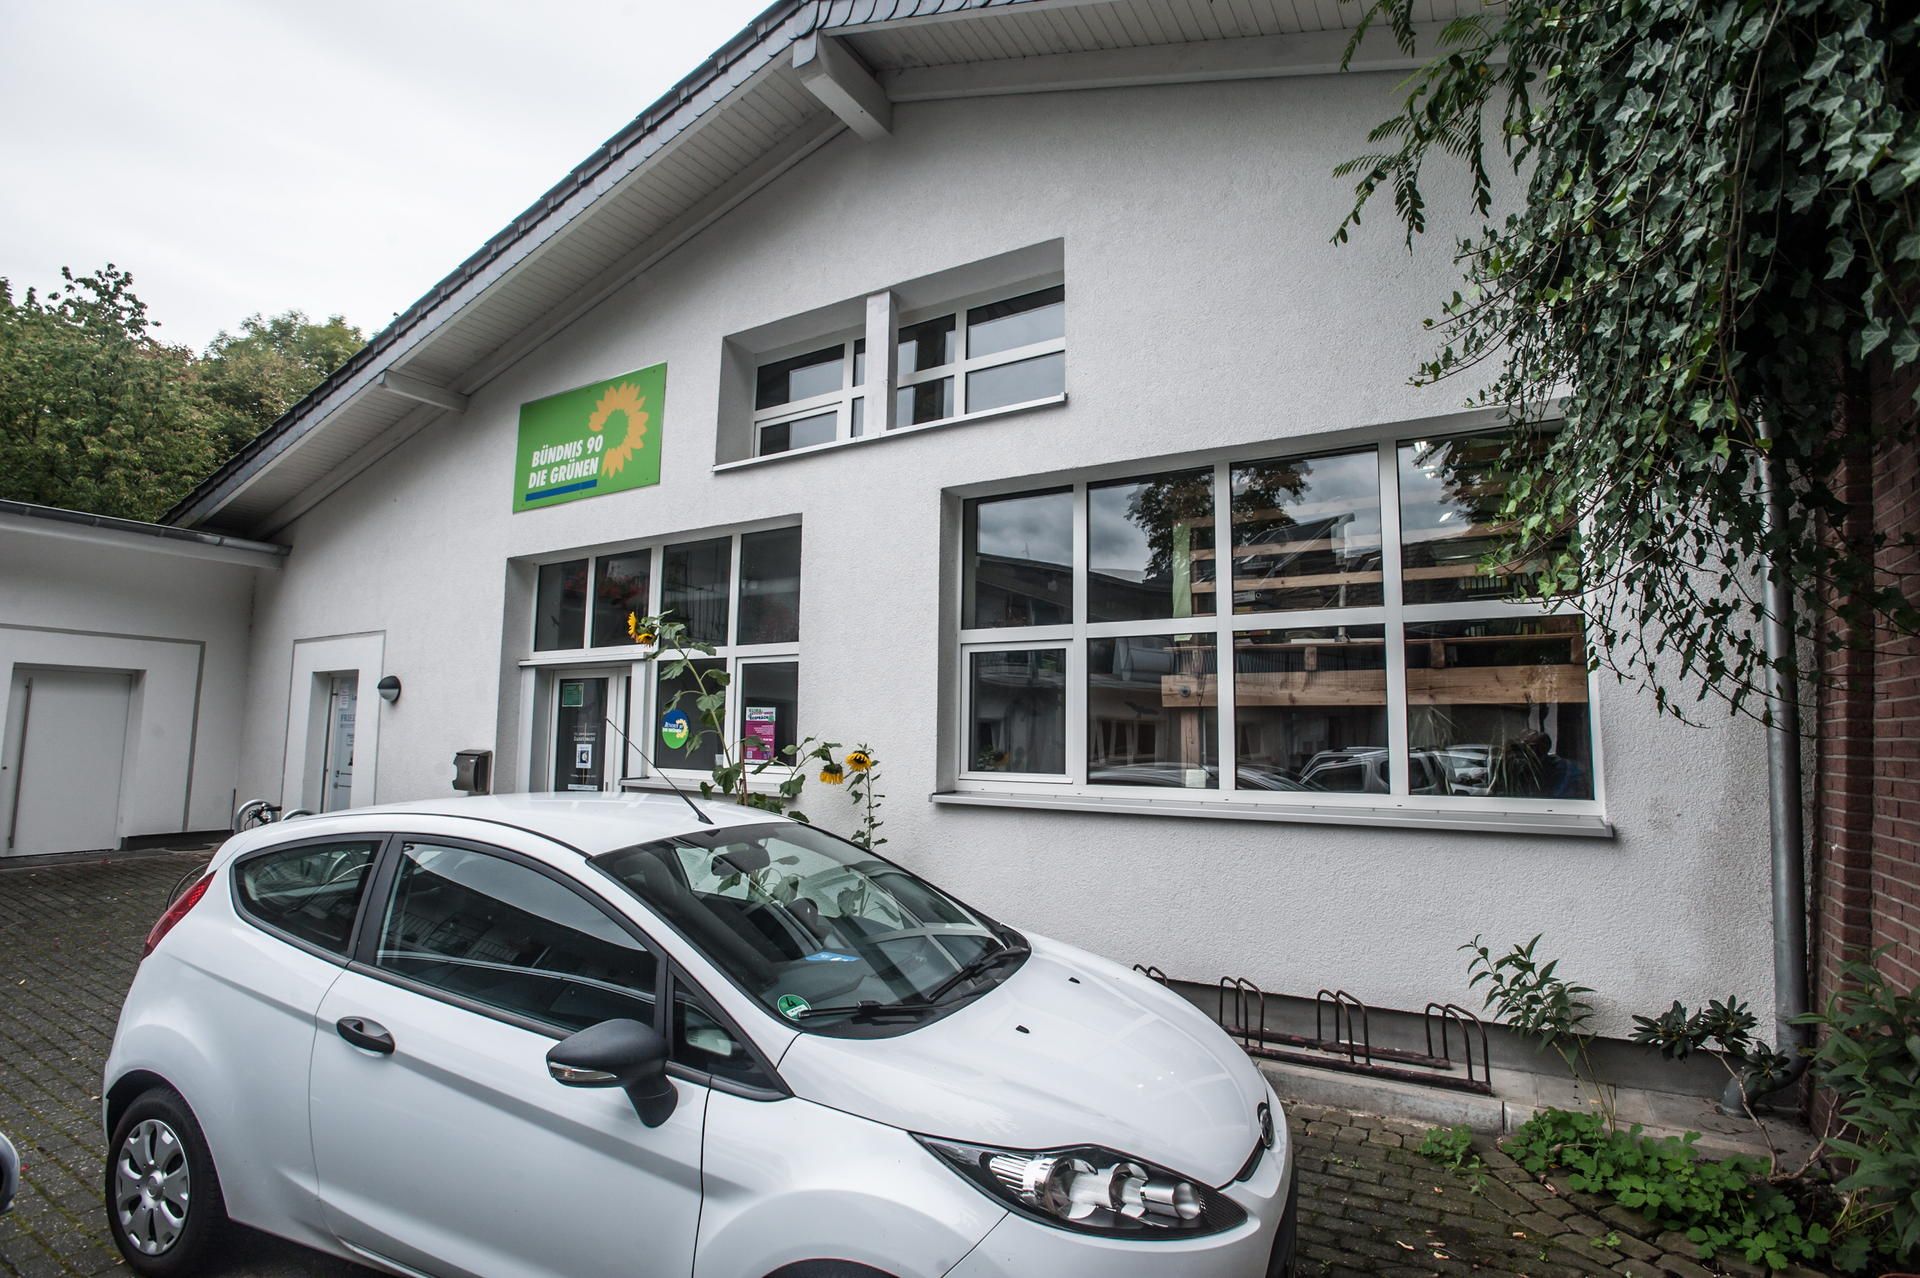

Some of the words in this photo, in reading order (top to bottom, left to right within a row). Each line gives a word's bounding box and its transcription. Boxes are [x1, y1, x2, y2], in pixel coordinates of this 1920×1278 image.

[531, 440, 583, 468] BÜNDNIS
[587, 434, 604, 454] 90
[528, 469, 547, 489] DIE
[550, 457, 599, 484] GRÜNEN
[785, 996, 797, 1007] 4
